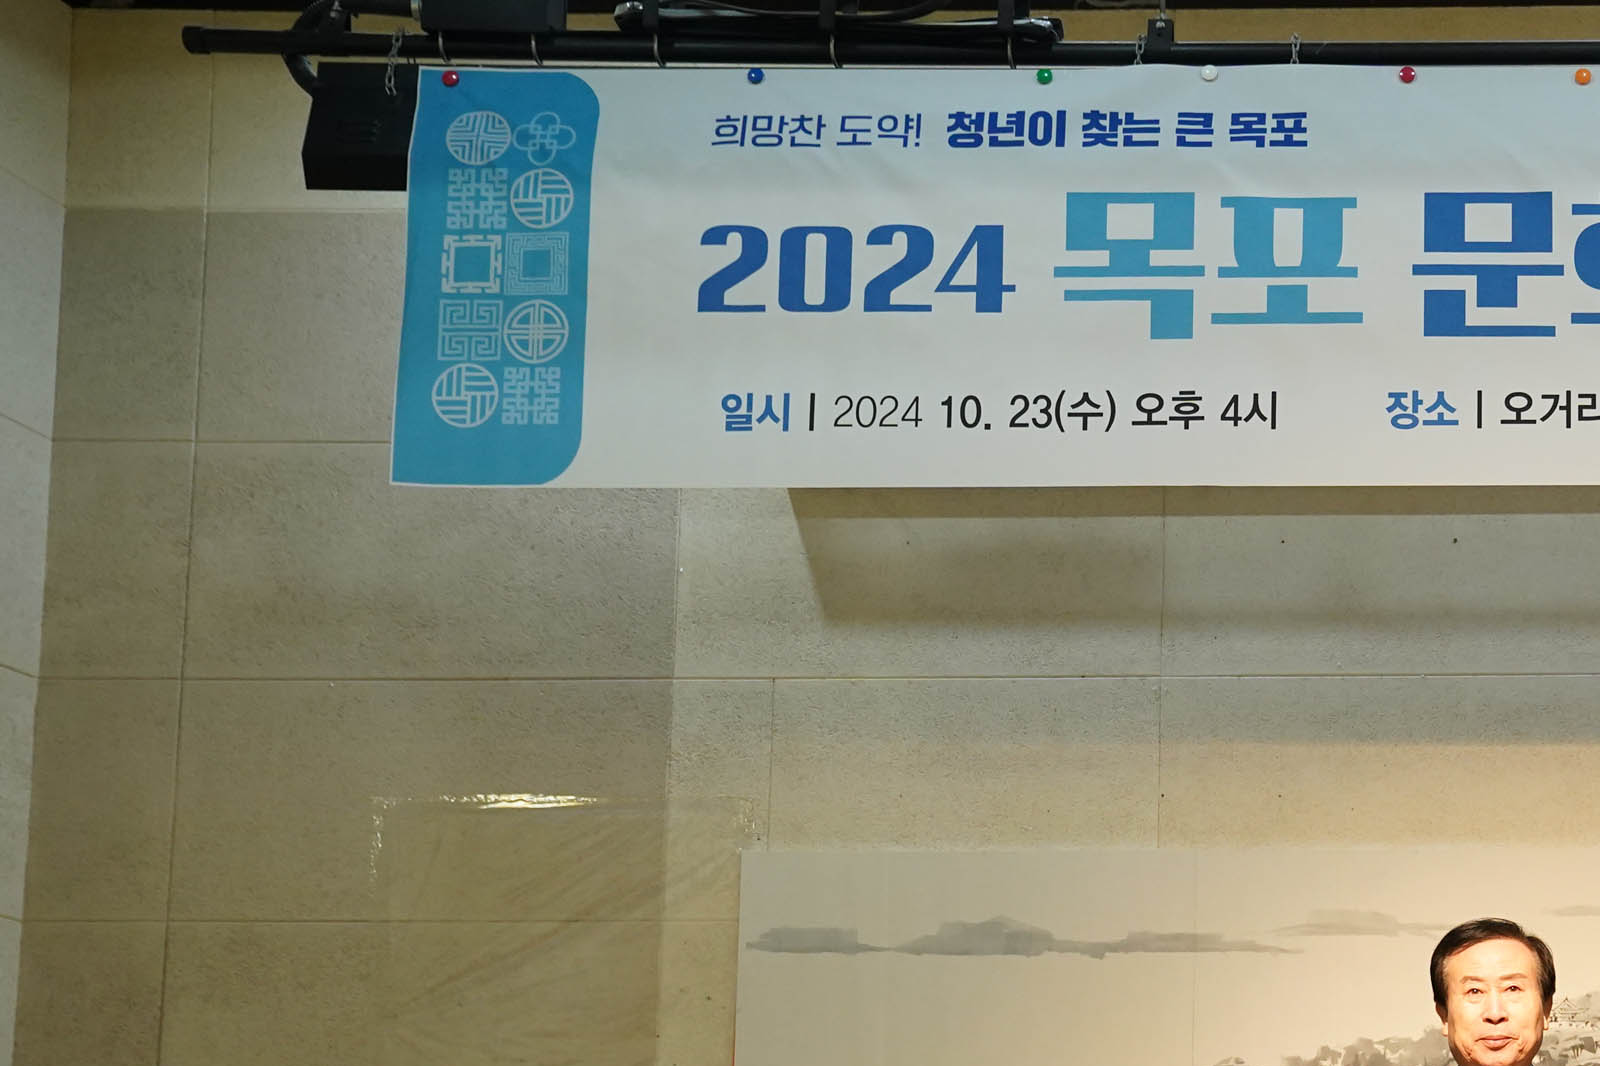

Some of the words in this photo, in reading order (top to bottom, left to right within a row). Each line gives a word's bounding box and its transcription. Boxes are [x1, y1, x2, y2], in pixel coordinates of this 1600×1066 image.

[712, 114, 826, 147] 희망찬
[836, 113, 921, 148] 도약!
[947, 110, 1067, 148] 청년이
[1082, 110, 1160, 147] 찾는
[1175, 112, 1214, 147] 큰
[1229, 112, 1308, 148] 목포
[697, 224, 1016, 313] 2024
[1053, 192, 1363, 340] 목포
[721, 392, 790, 432] 일시
[834, 395, 922, 428] 2024
[941, 395, 991, 430] 10.
[1009, 390, 1116, 433] 23(수)
[1131, 390, 1205, 430] 오후
[1220, 391, 1277, 430] 4시
[1385, 390, 1459, 430] 장소
